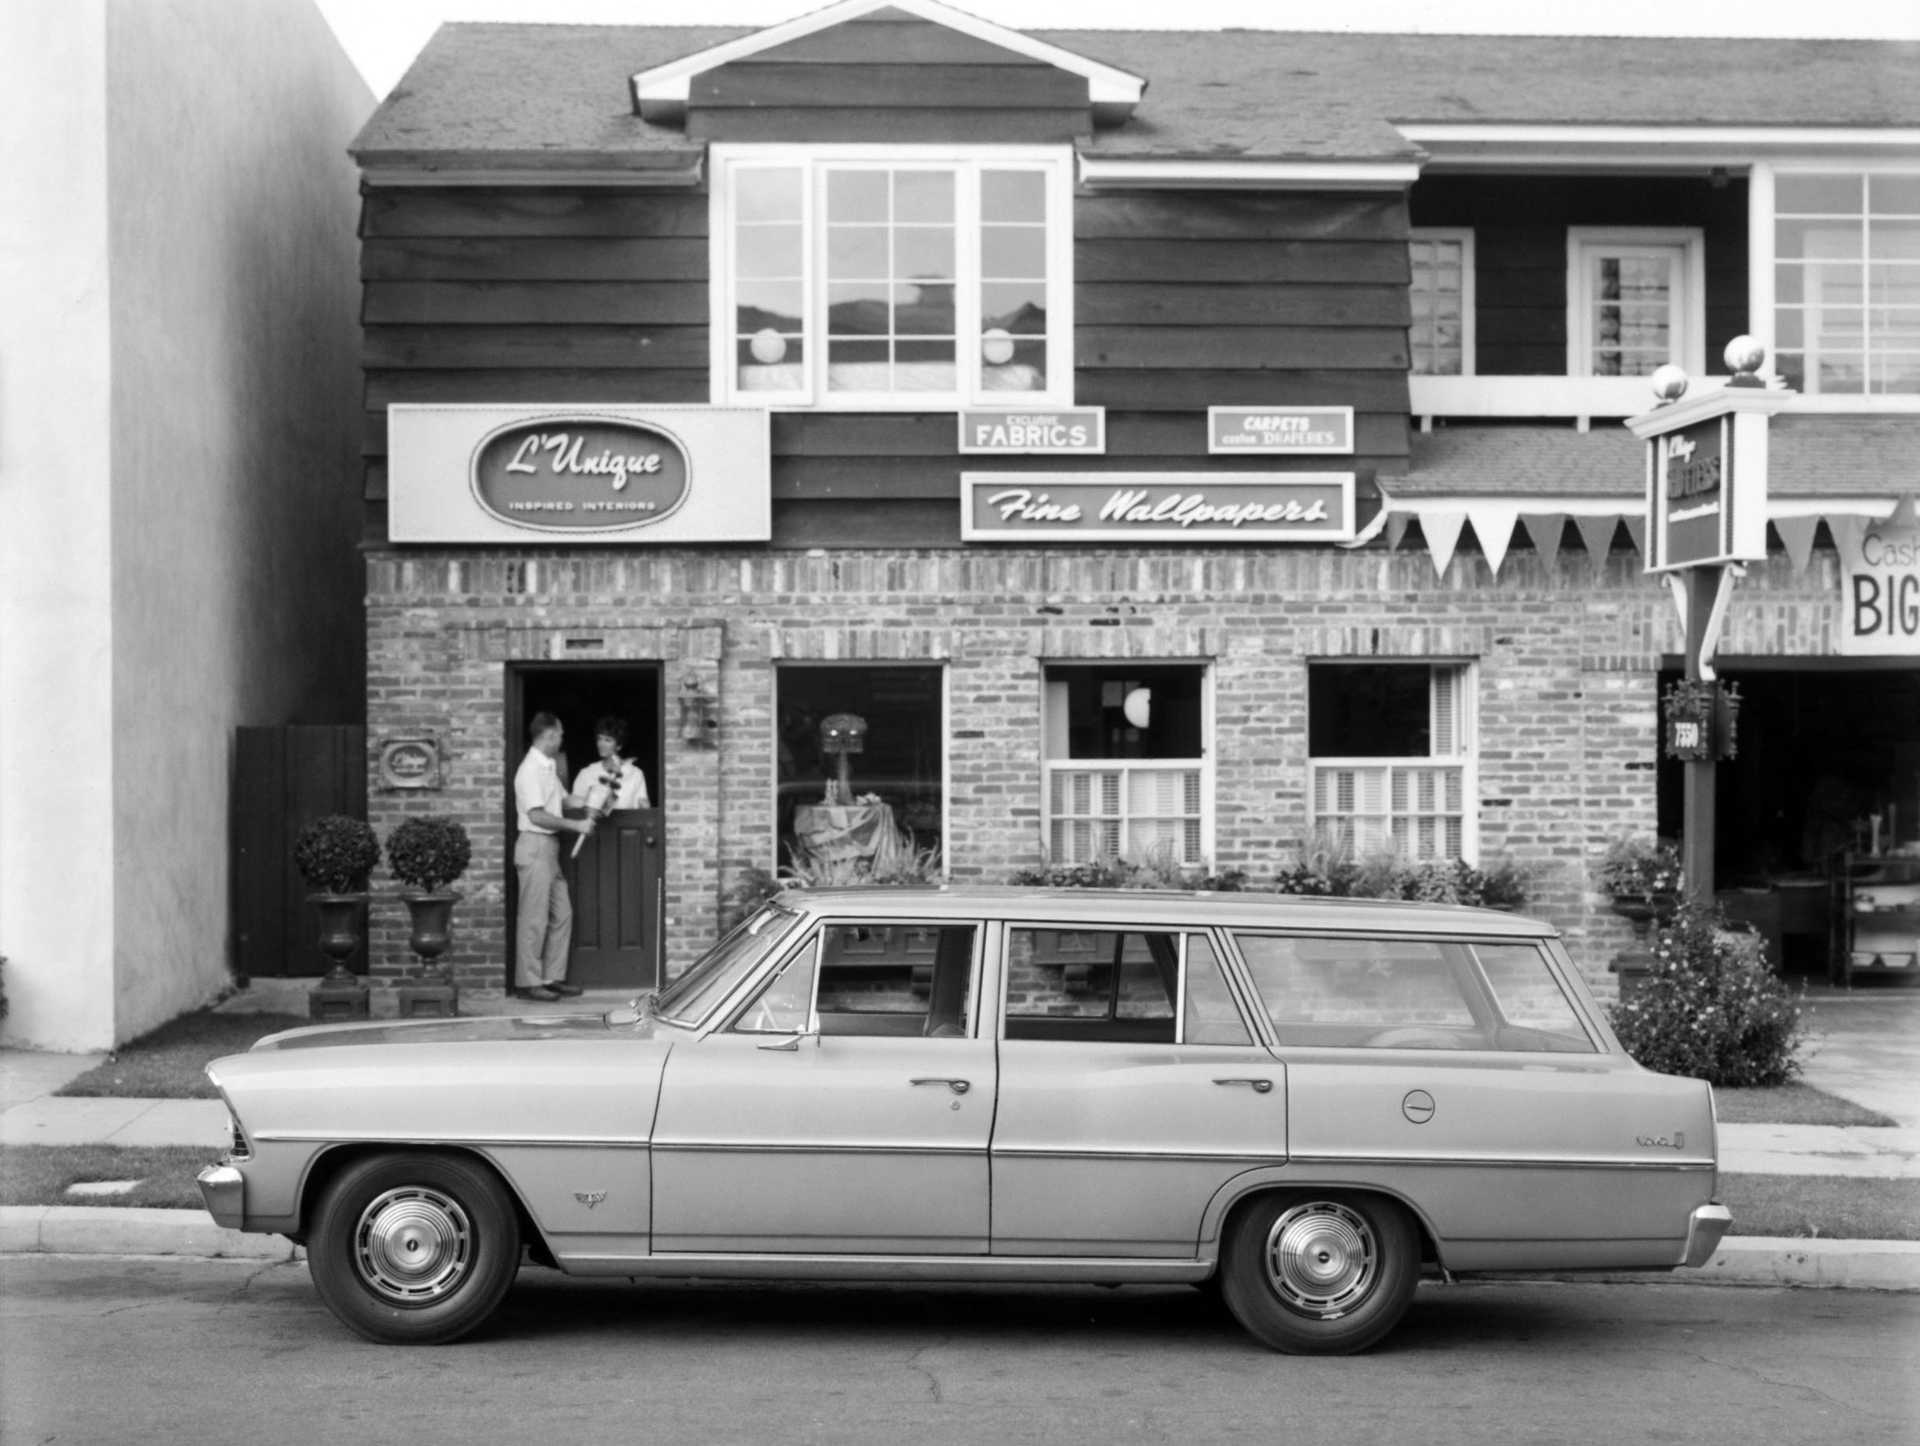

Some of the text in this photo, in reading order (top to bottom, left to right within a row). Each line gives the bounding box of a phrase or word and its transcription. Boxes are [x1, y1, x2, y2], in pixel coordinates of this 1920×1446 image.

[976, 425, 1088, 447] FABRICS
[1243, 416, 1311, 431] CARPETS
[505, 432, 662, 491] L'Unique
[508, 501, 656, 511] INSPIRED INTERIORS
[986, 489, 1329, 528] Fine Wallpapers
[1852, 573, 1920, 636] BIG
